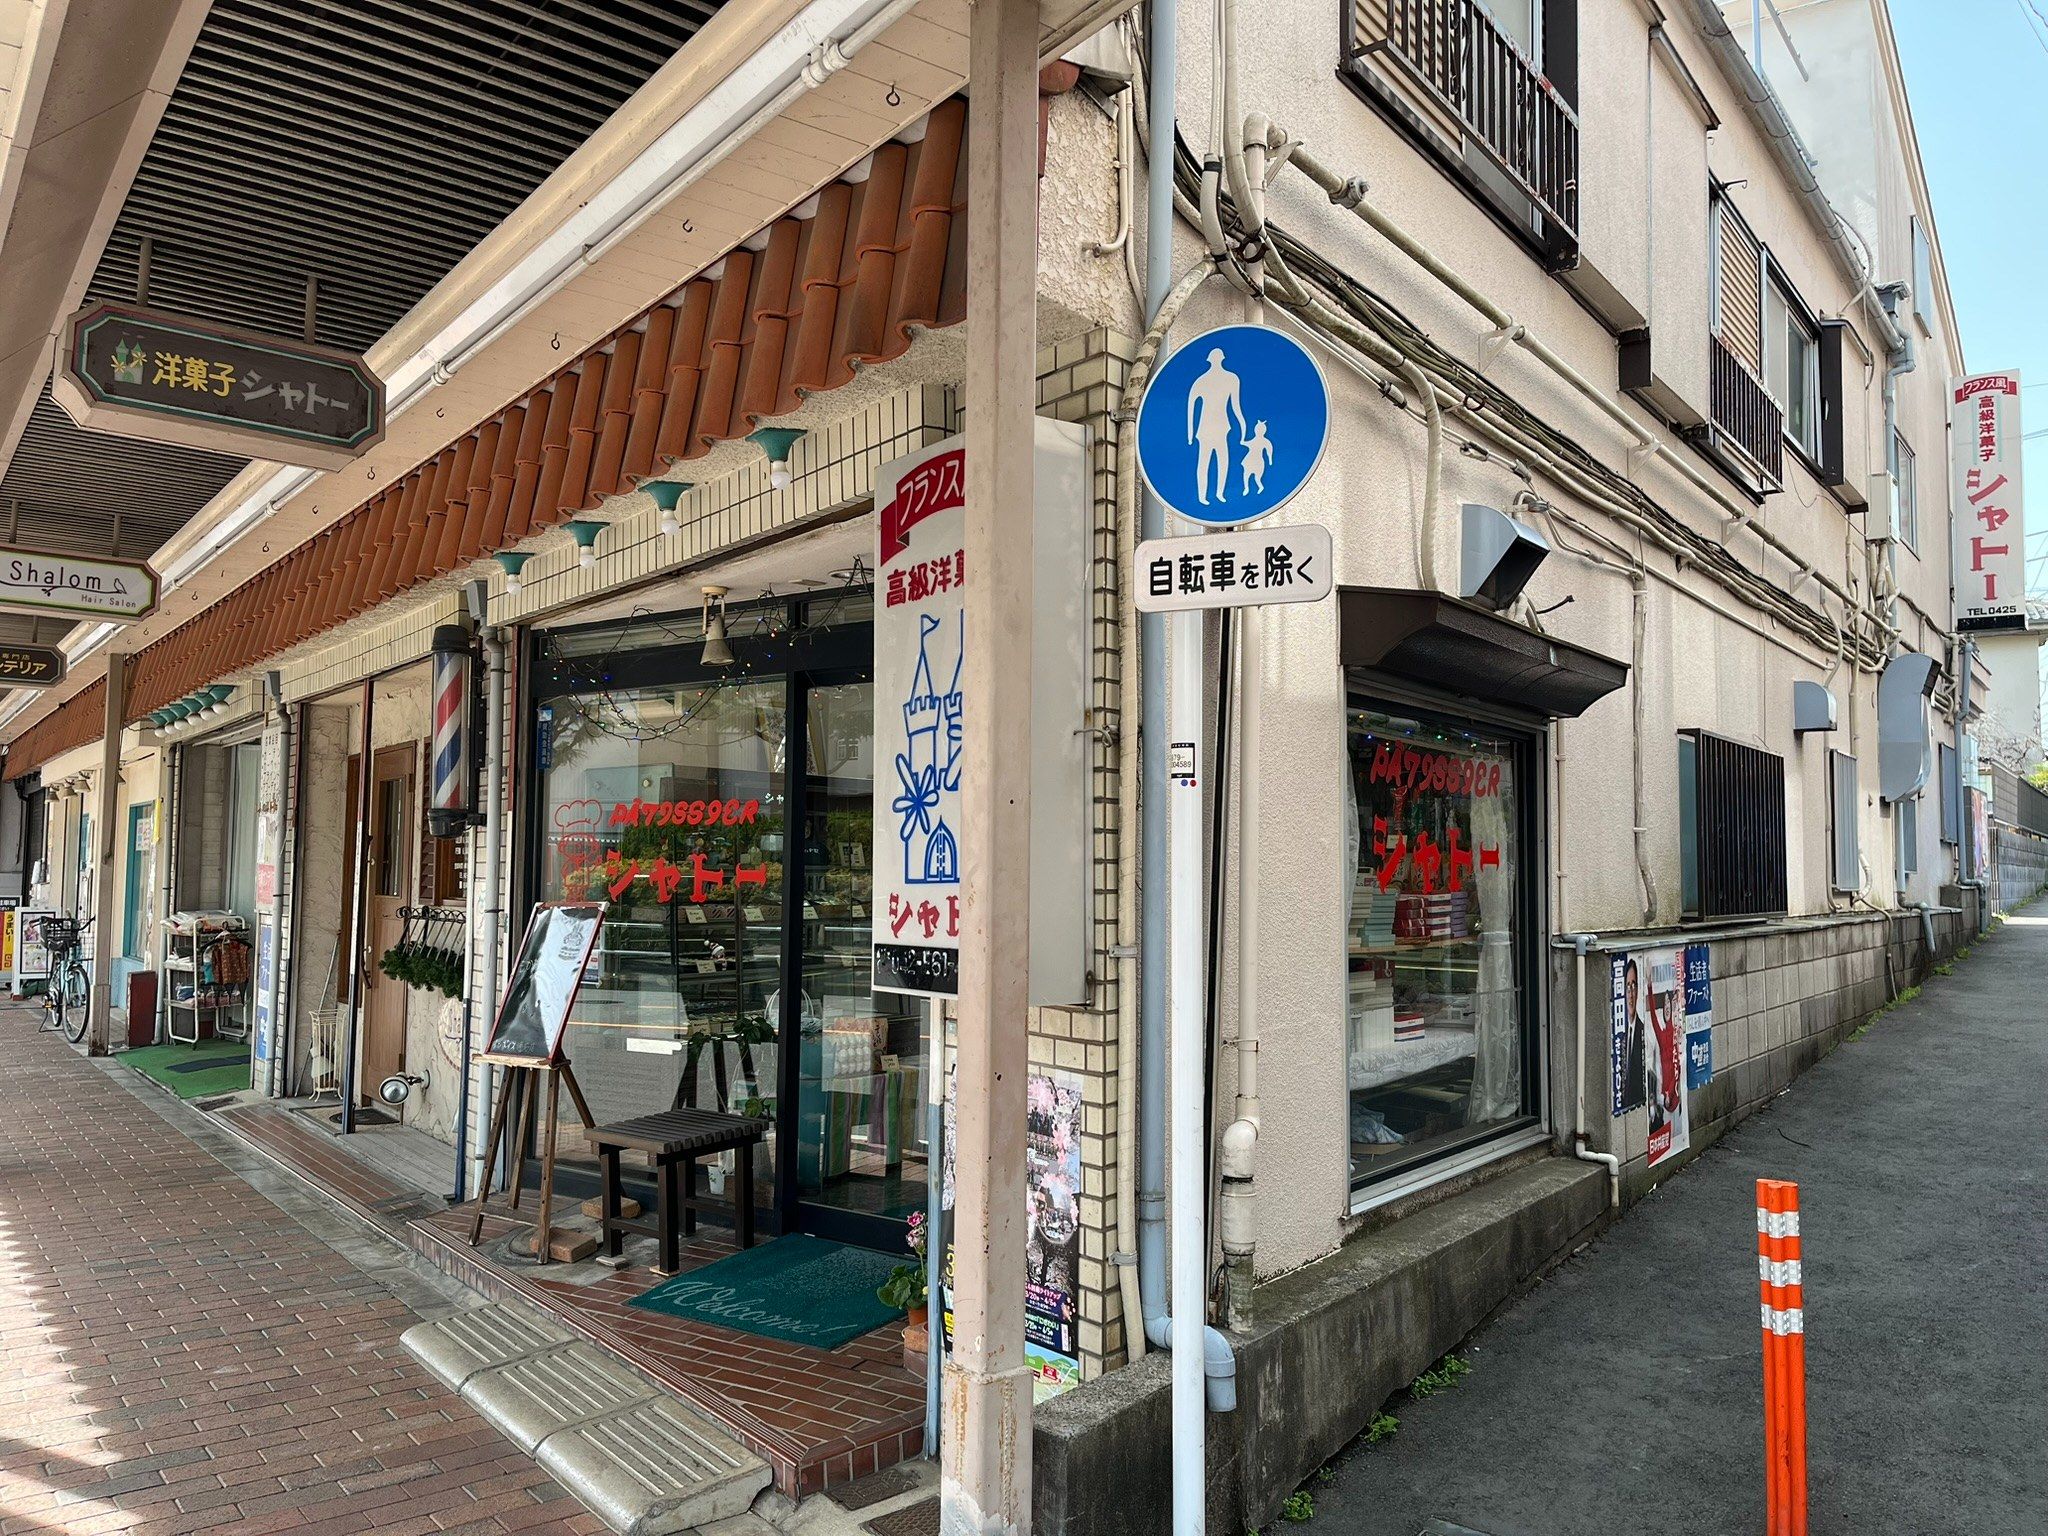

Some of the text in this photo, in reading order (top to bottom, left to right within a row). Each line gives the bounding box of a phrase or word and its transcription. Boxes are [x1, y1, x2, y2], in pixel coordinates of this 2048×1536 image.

[152, 352, 349, 415] 洋菓子 シャトー
[1963, 376, 2008, 396] フランス風
[1978, 395, 1996, 463] 高級洋菓子
[899, 458, 966, 526] フランス
[1965, 468, 2010, 601] シャトー
[10, 560, 101, 590] Shalom
[1149, 544, 1314, 597] 自転車を除く
[81, 594, 137, 608] Hair Salon
[1967, 605, 2017, 616] TEL 0425
[606, 849, 768, 904] シャトー
[1372, 813, 1500, 895] シャトー
[650, 1281, 858, 1336] Welcome!
